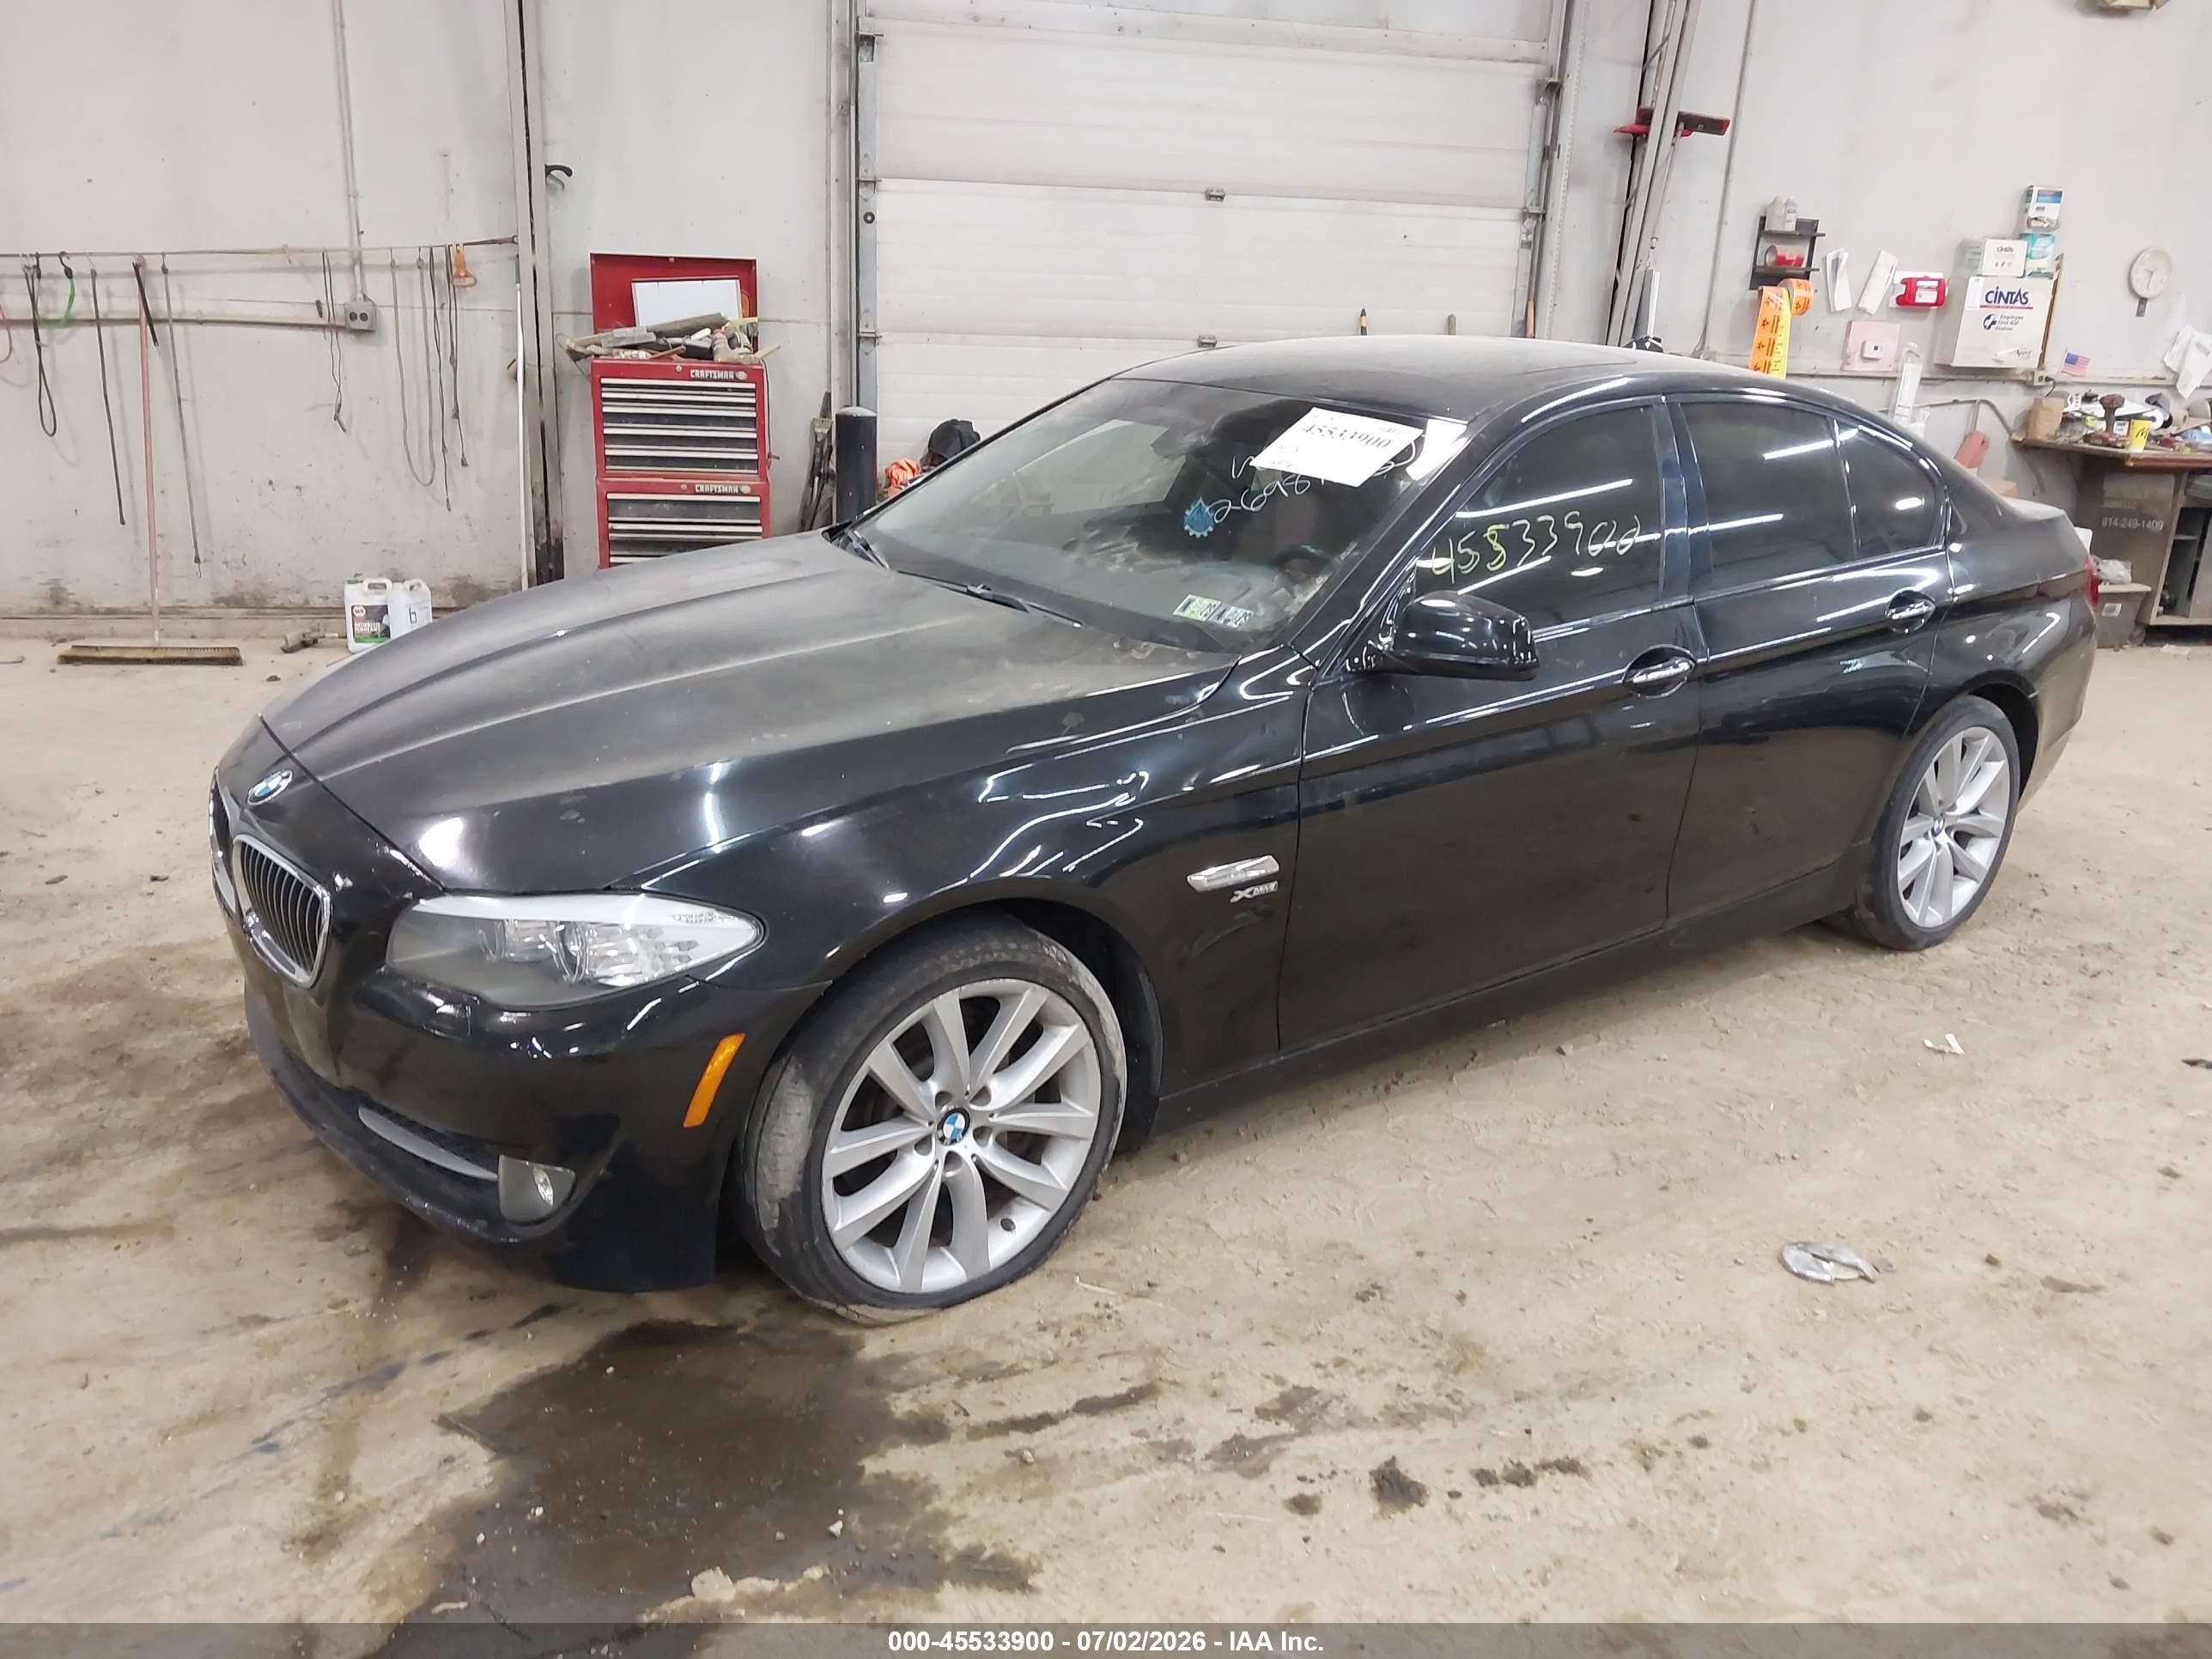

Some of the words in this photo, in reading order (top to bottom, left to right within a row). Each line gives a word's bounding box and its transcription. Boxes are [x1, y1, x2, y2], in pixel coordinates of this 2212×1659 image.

[1984, 286, 2029, 305] CINTAS
[690, 369, 734, 380] CRAFTSMAN
[695, 484, 739, 494] CRAFTSMAN
